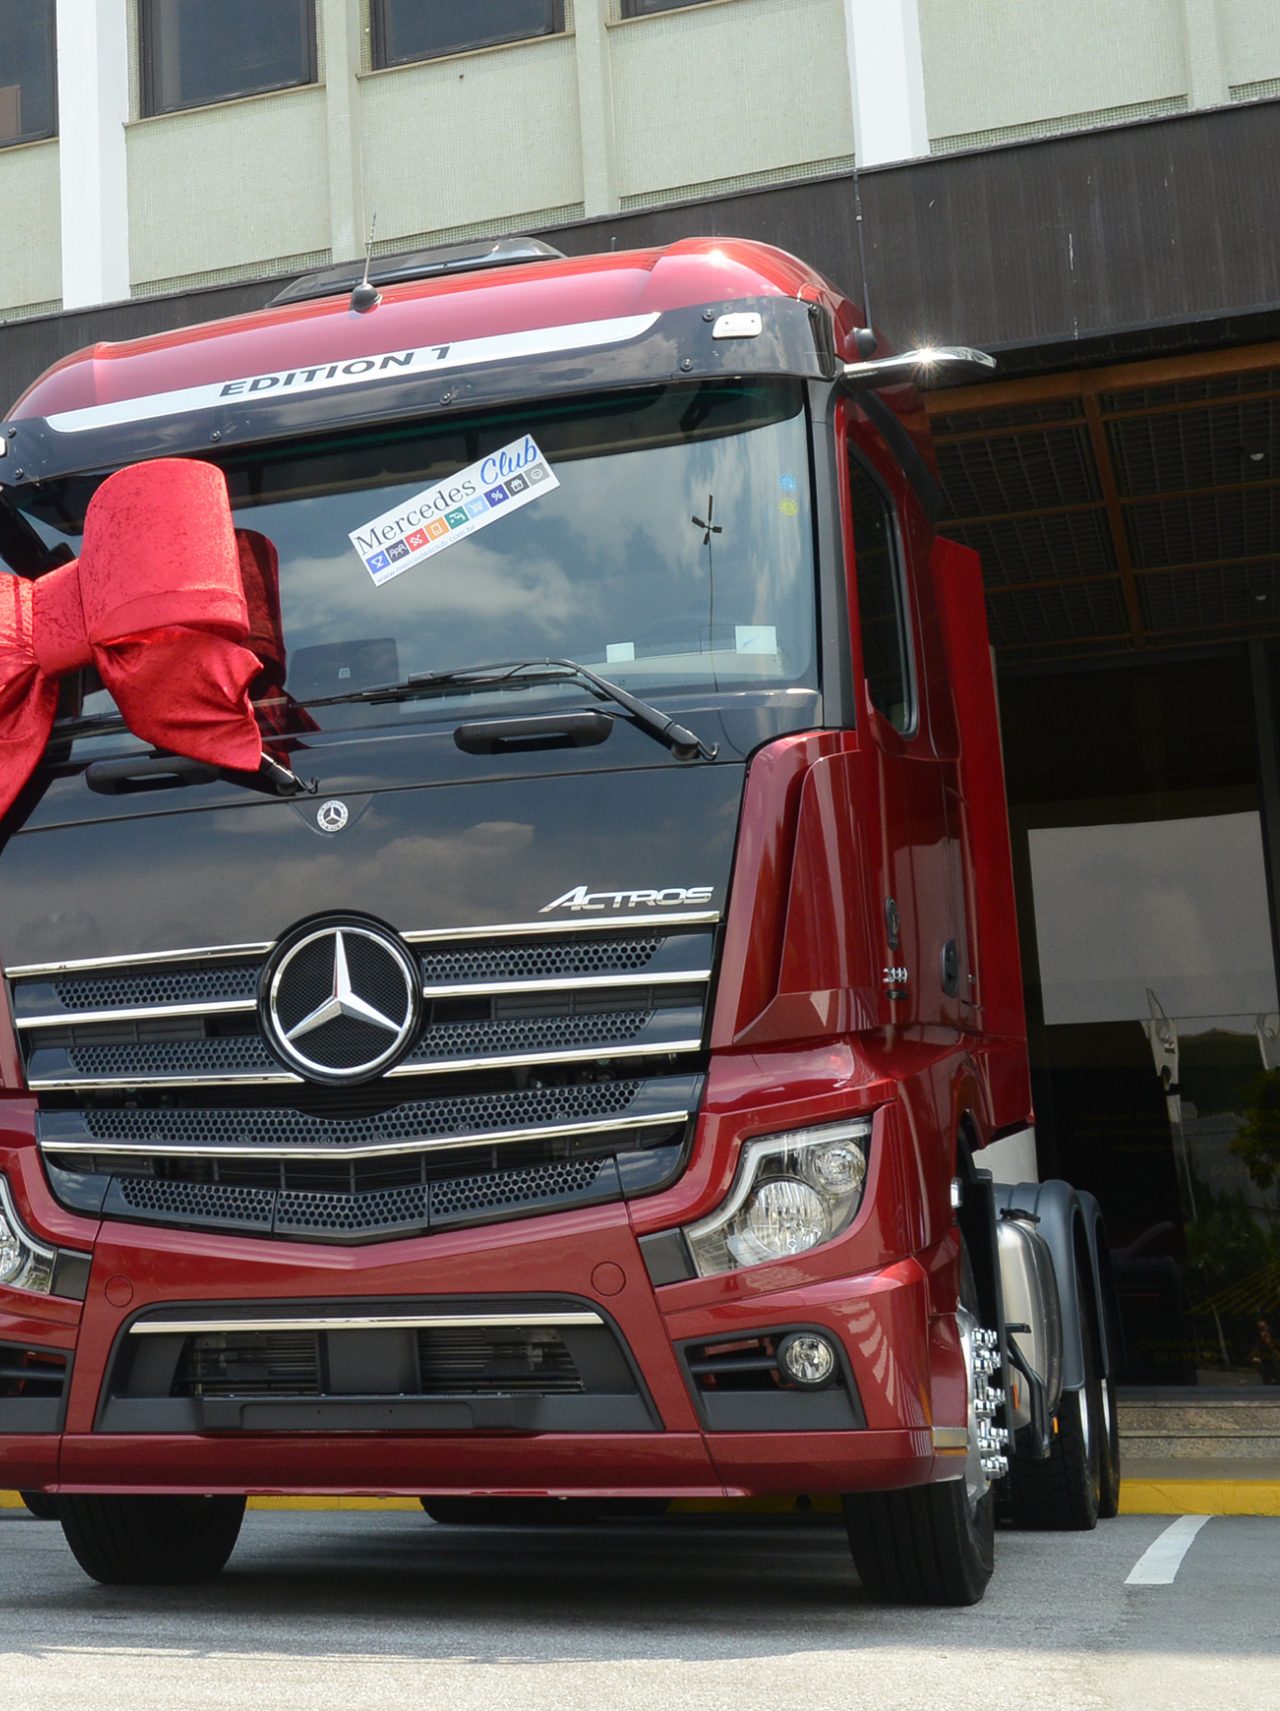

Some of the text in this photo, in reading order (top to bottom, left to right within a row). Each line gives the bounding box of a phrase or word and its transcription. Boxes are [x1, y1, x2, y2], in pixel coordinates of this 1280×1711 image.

[220, 347, 450, 397] EDITION 1
[353, 437, 537, 555] Mercedes Club
